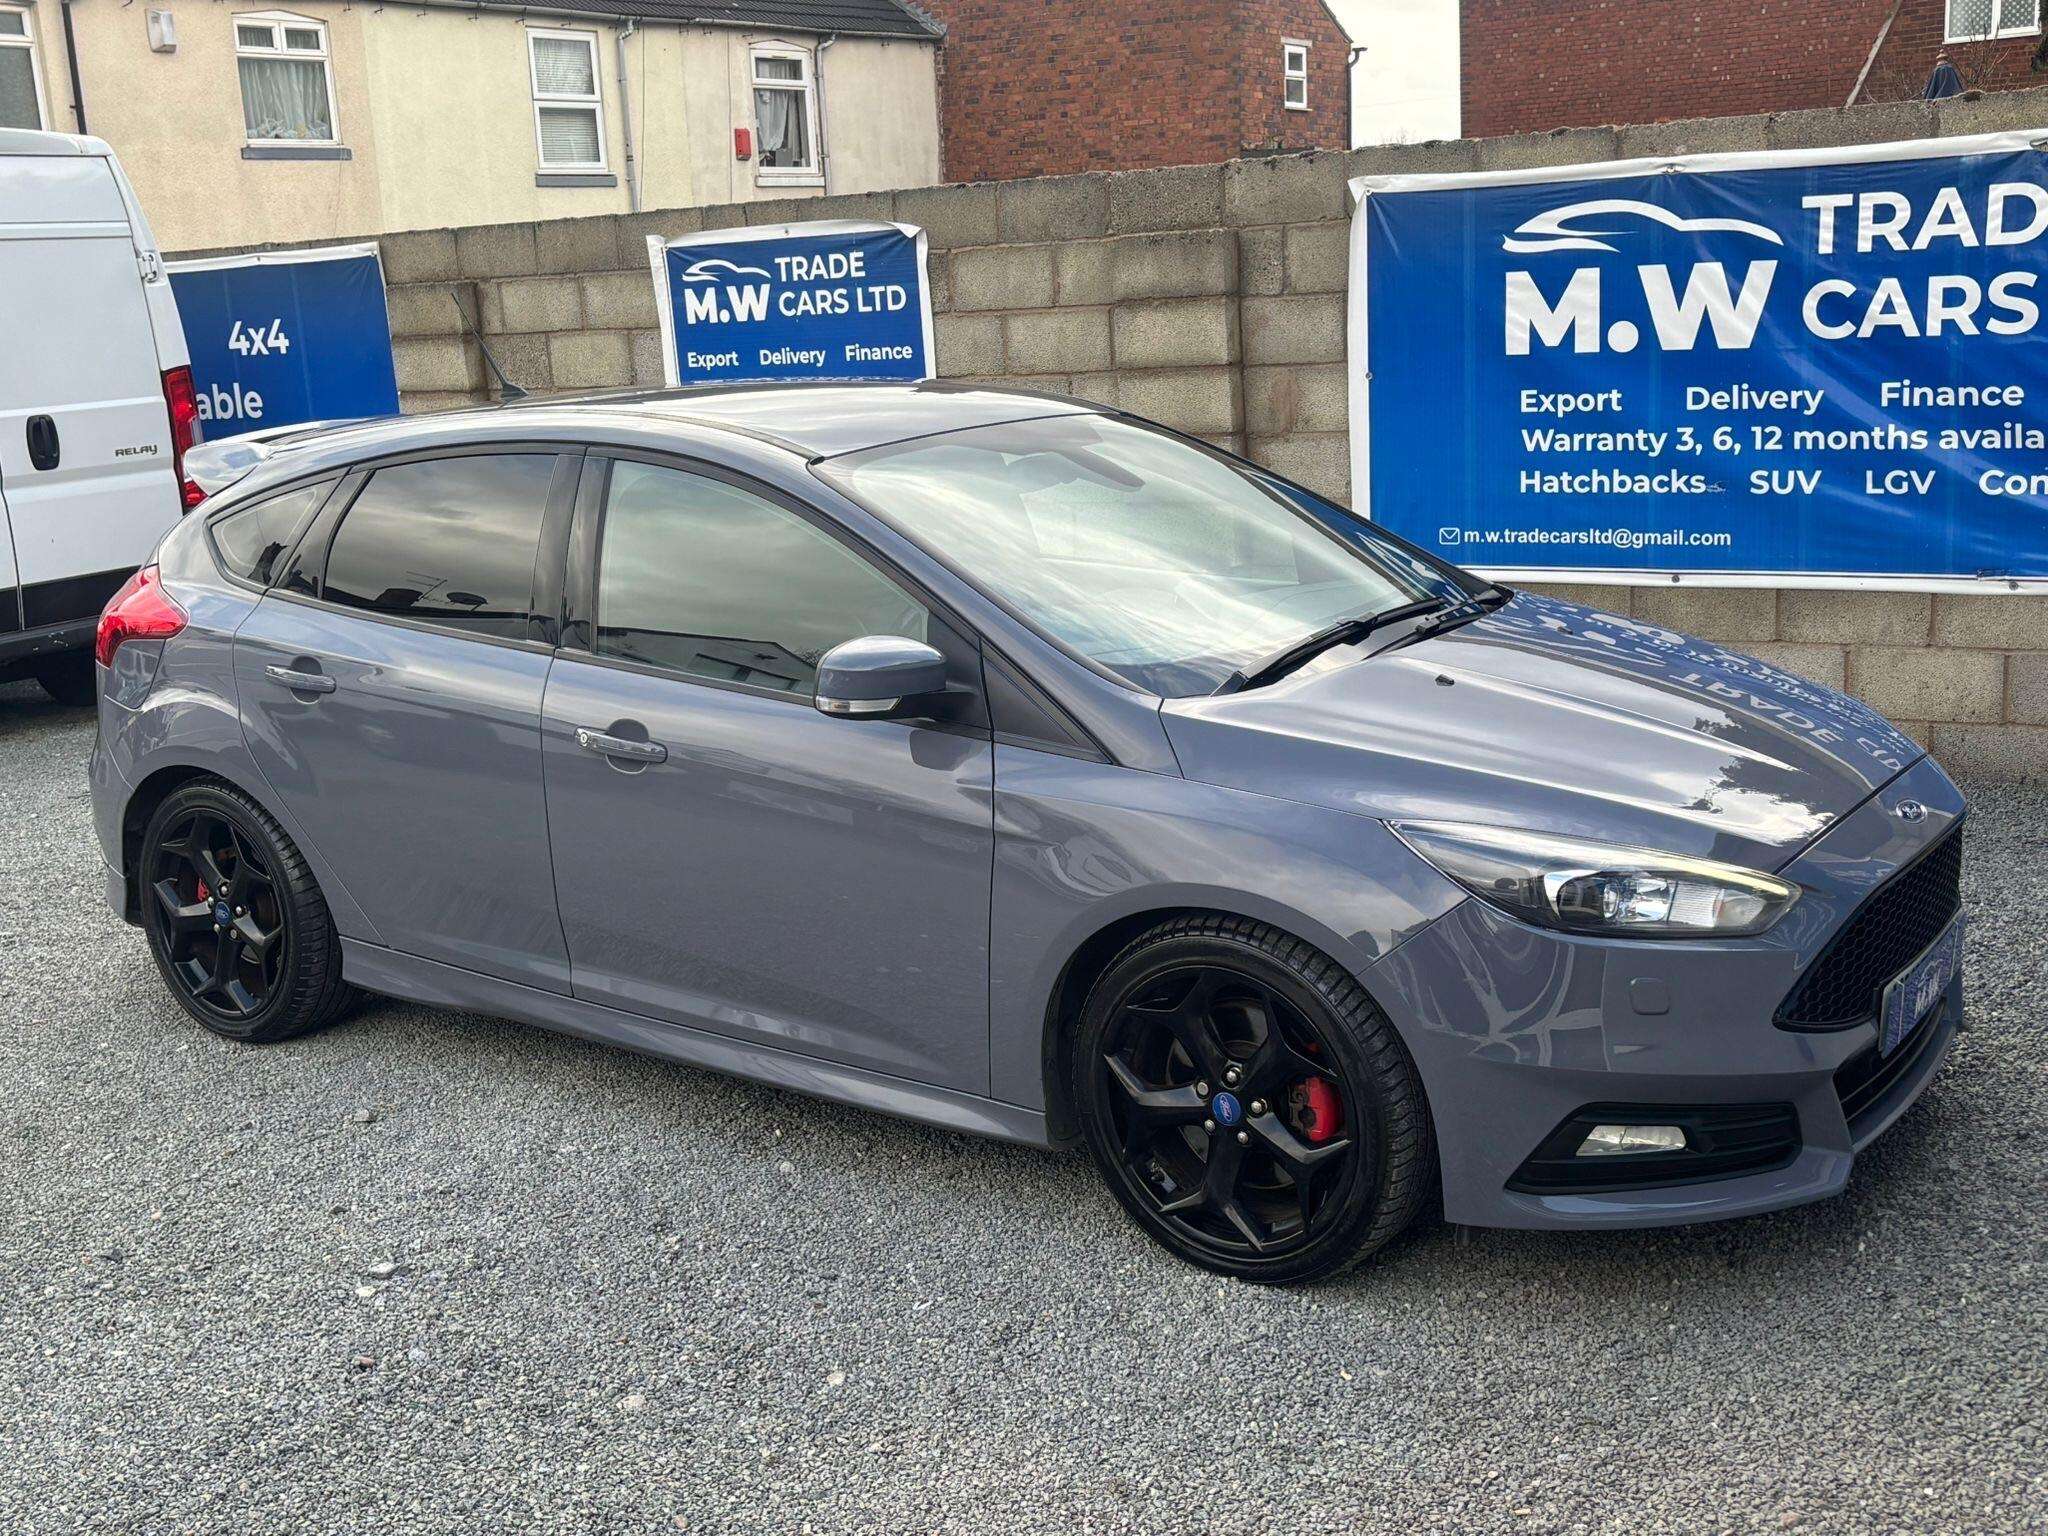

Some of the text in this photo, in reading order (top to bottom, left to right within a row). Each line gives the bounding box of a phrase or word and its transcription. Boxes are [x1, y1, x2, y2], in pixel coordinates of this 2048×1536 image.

[1802, 182, 2048, 254] TRAD
[774, 251, 865, 282] TRADE
[684, 284, 770, 324] M.W
[779, 285, 906, 316] CARS LTD
[1505, 260, 1778, 355] M.W
[1802, 271, 2039, 339] CARS
[229, 319, 289, 355] 4x4
[688, 344, 912, 370] Export Delivery Finance
[1520, 379, 2024, 417] Export Delivery Finance
[115, 445, 157, 456] RELAY
[1521, 422, 2044, 457] Warranty 3, 6, 12 months availa
[1520, 469, 1706, 494] Hatchbacks
[1750, 470, 1822, 495] SUV
[1866, 470, 1935, 495] LGV
[1464, 528, 1731, 548] m.w.tradecarsltd@gmail.com
